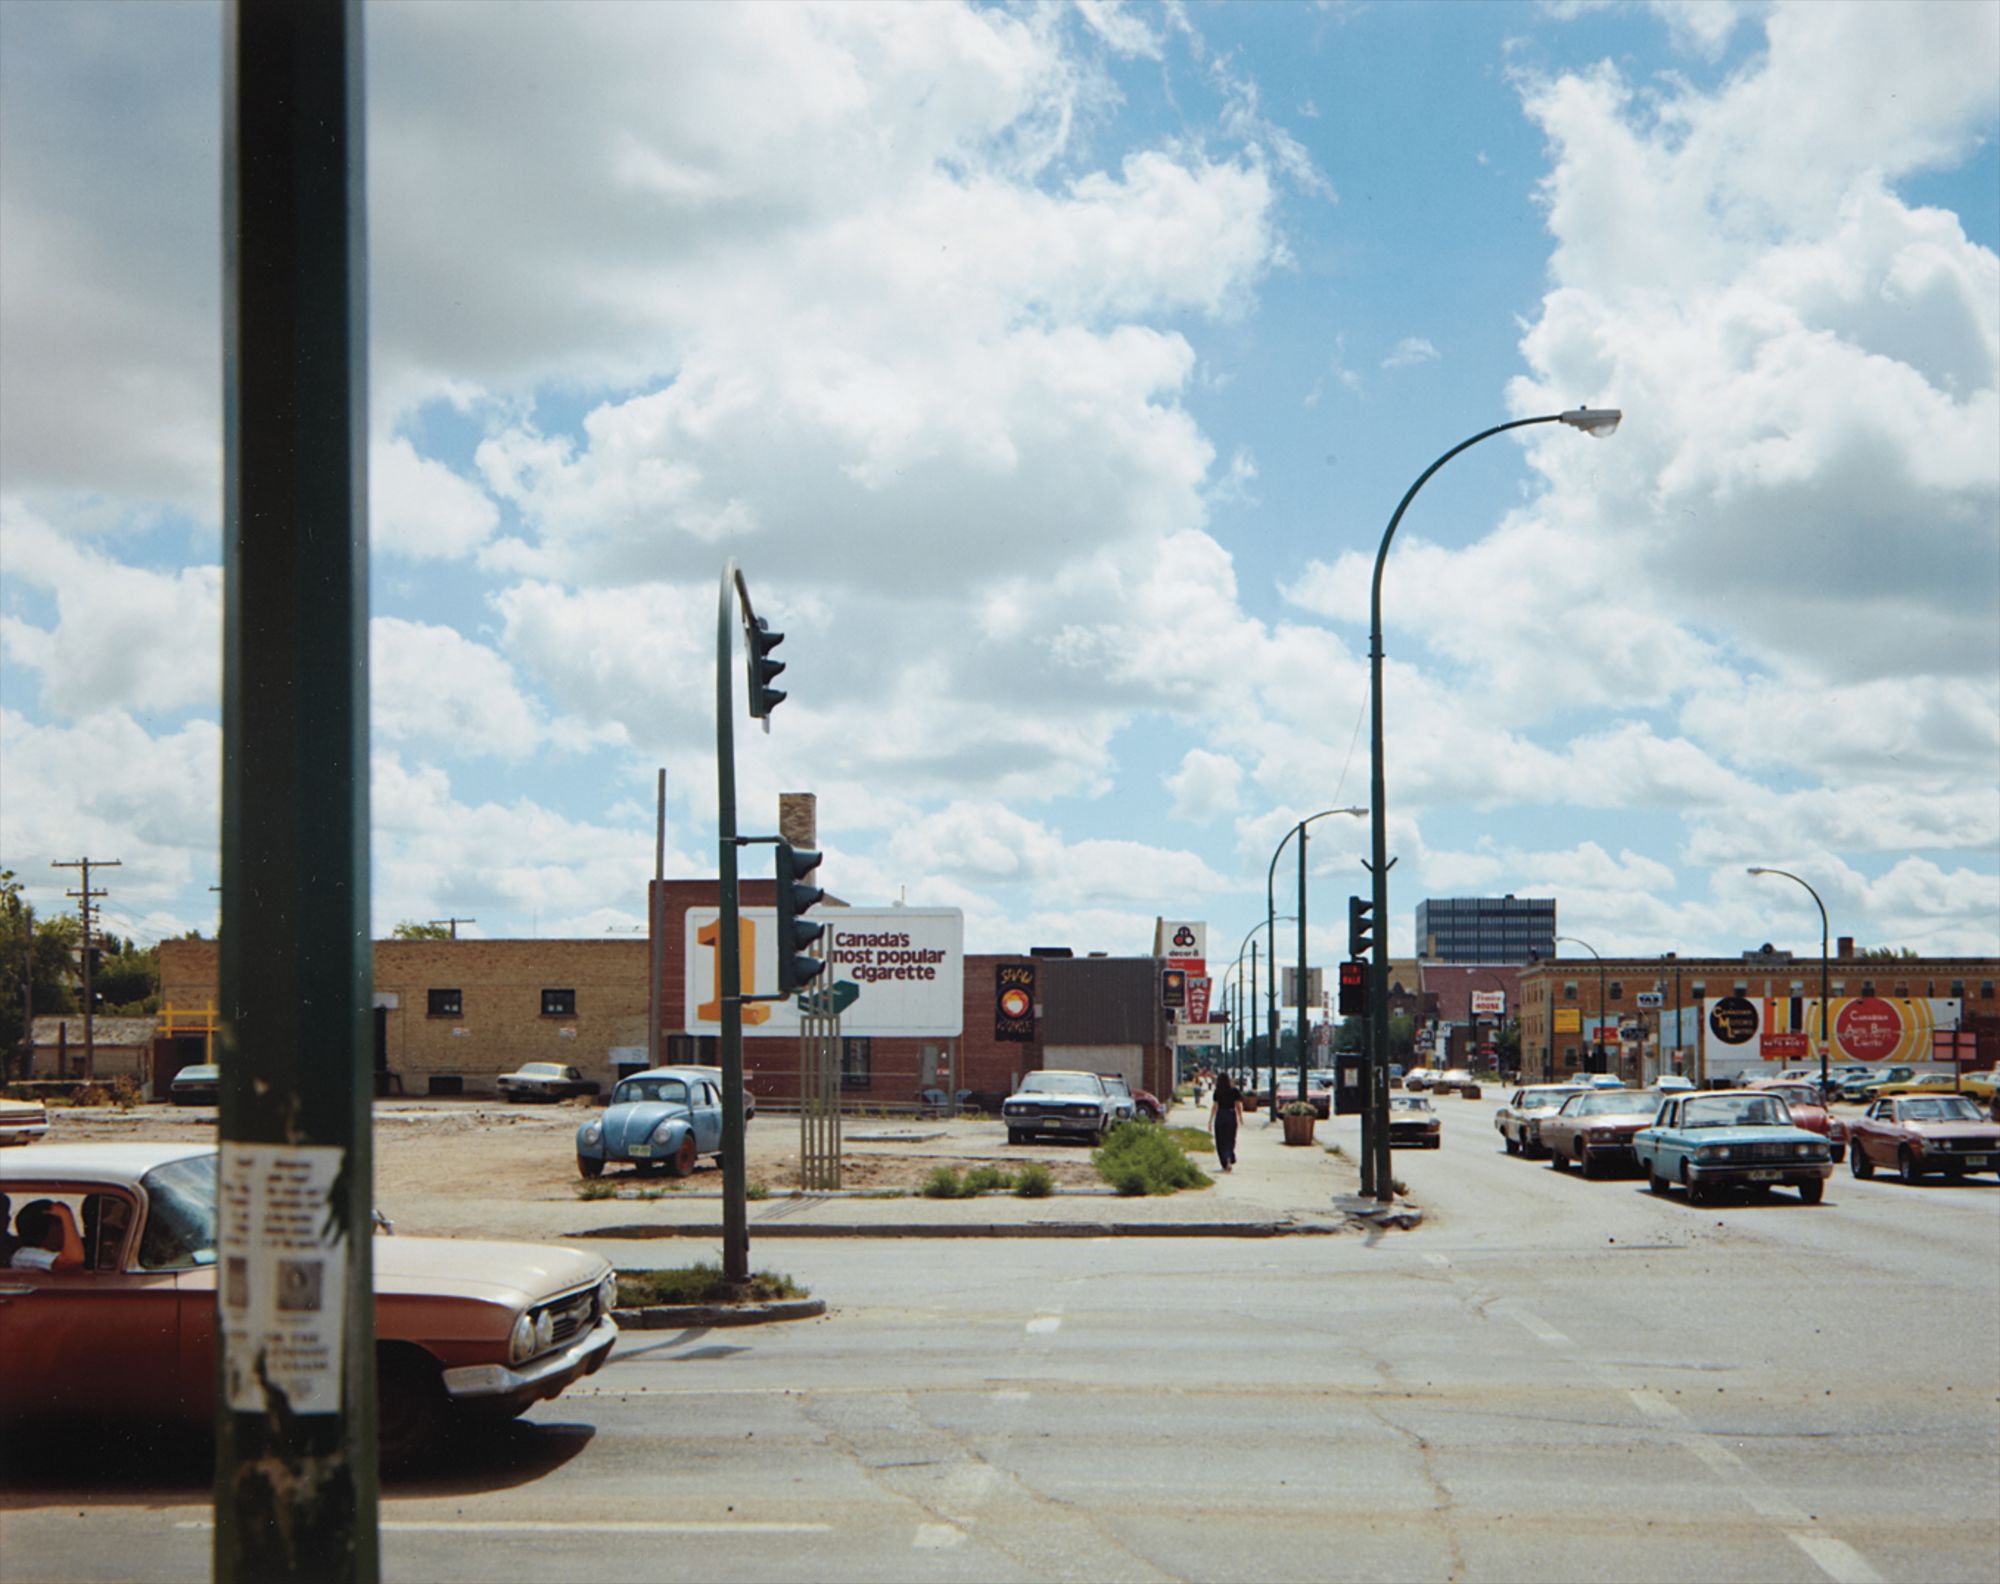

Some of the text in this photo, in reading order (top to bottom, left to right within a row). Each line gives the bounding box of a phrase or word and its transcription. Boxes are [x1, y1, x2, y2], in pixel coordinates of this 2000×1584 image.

[835, 932, 910, 947] Canada's
[877, 948, 946, 965] popular
[851, 964, 936, 983] cigarette
